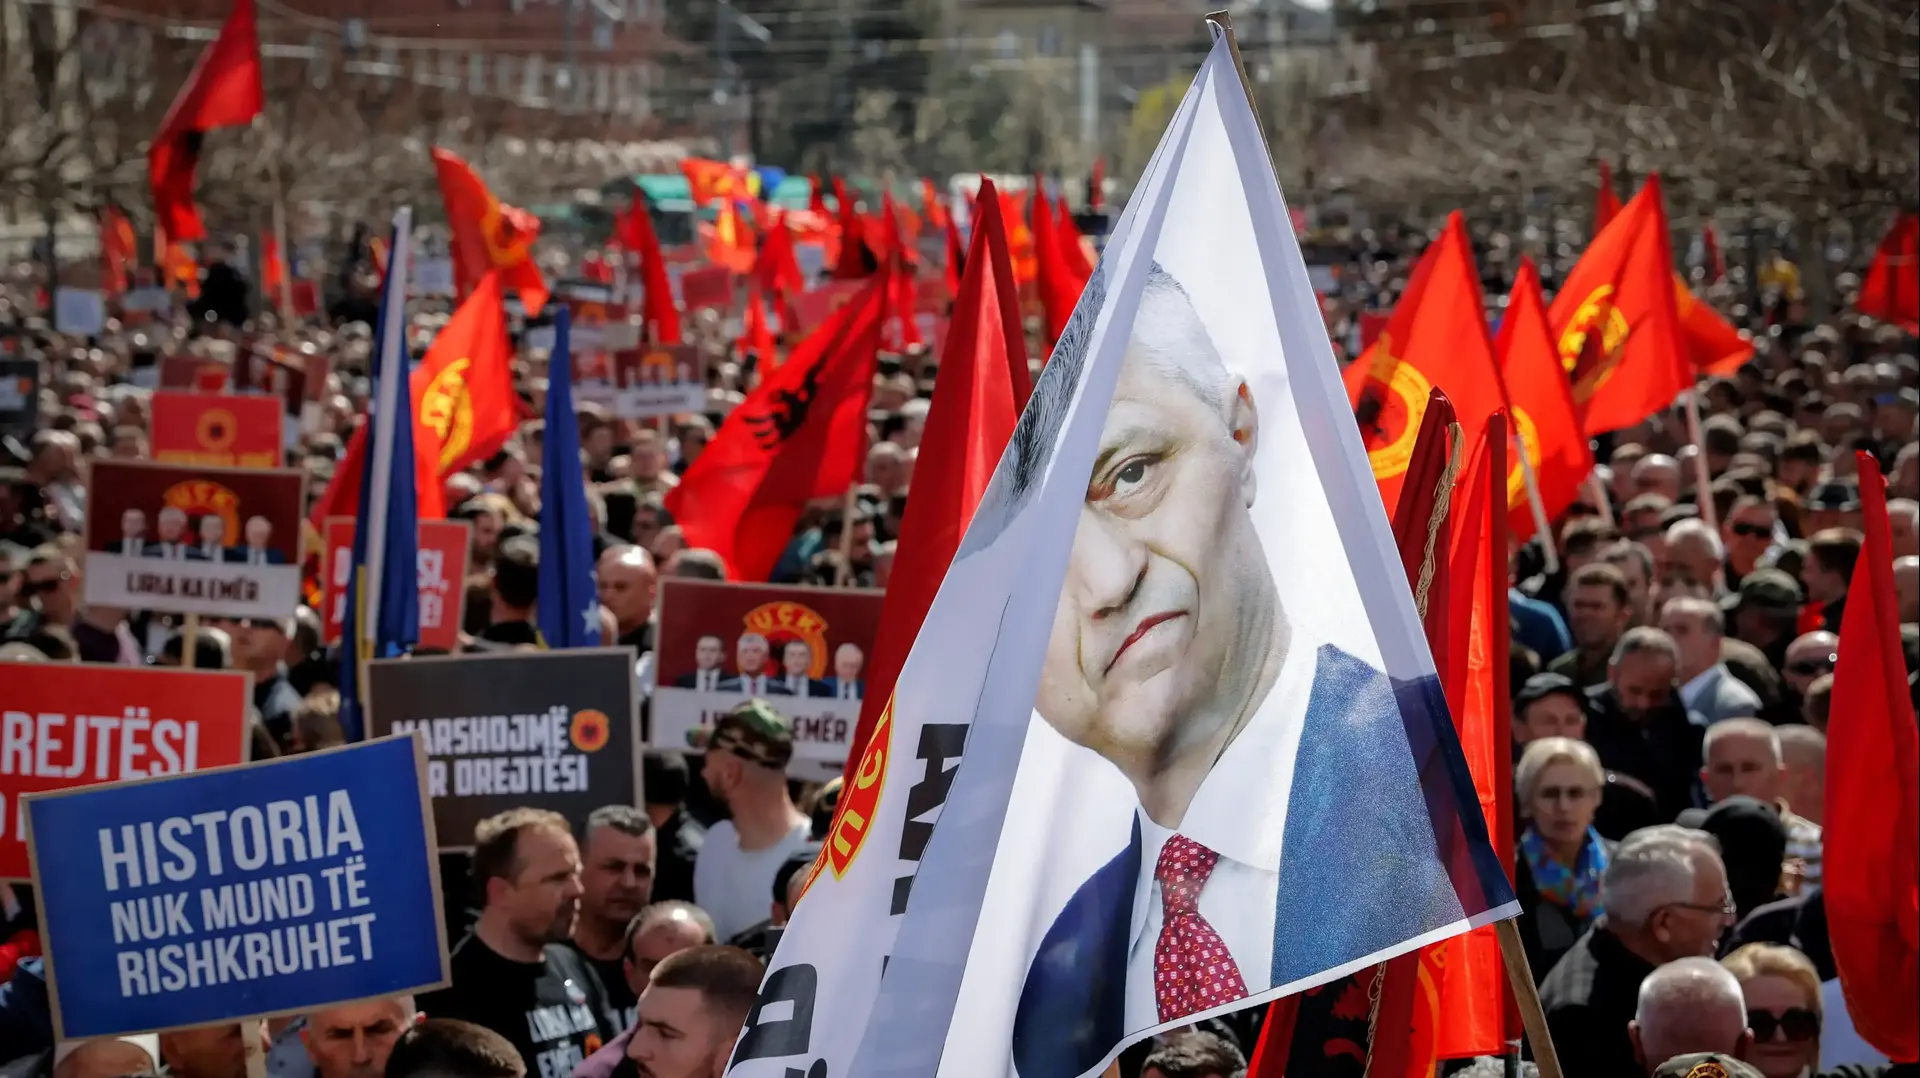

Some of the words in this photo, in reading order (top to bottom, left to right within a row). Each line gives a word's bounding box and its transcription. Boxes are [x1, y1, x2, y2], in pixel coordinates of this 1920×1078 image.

[453, 749, 589, 797] DREJTËSI
[98, 789, 364, 891] HISTORIA
[110, 892, 194, 944] NUK
[201, 867, 315, 931] MUND
[321, 855, 370, 911] TË
[117, 914, 376, 997] RISHKRUHET
